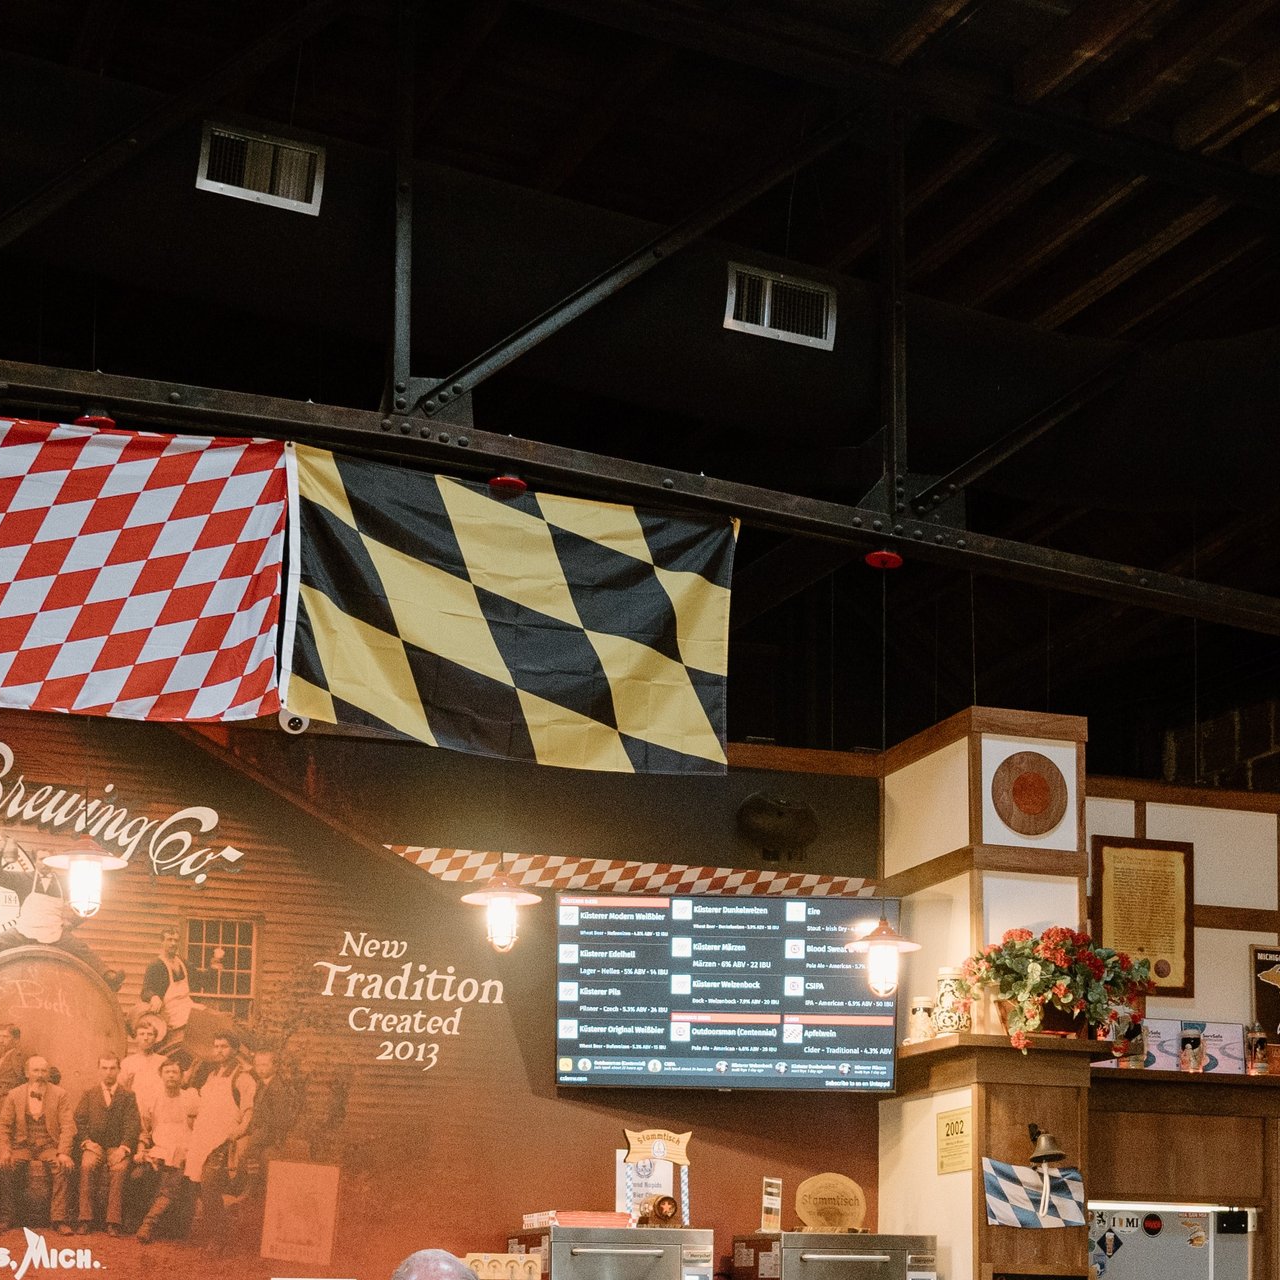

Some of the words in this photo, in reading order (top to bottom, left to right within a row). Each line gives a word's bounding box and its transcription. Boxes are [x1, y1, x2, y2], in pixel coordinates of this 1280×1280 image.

[149, 806, 244, 884] Co.
[339, 931, 408, 959] New
[313, 961, 504, 1004] Tradition
[348, 1006, 463, 1035] Created
[376, 1041, 440, 1071] 2013
[945, 1119, 964, 1137] 2002
[801, 1194, 860, 1207] Stammtisch
[14, 1226, 102, 1280] MICH.
